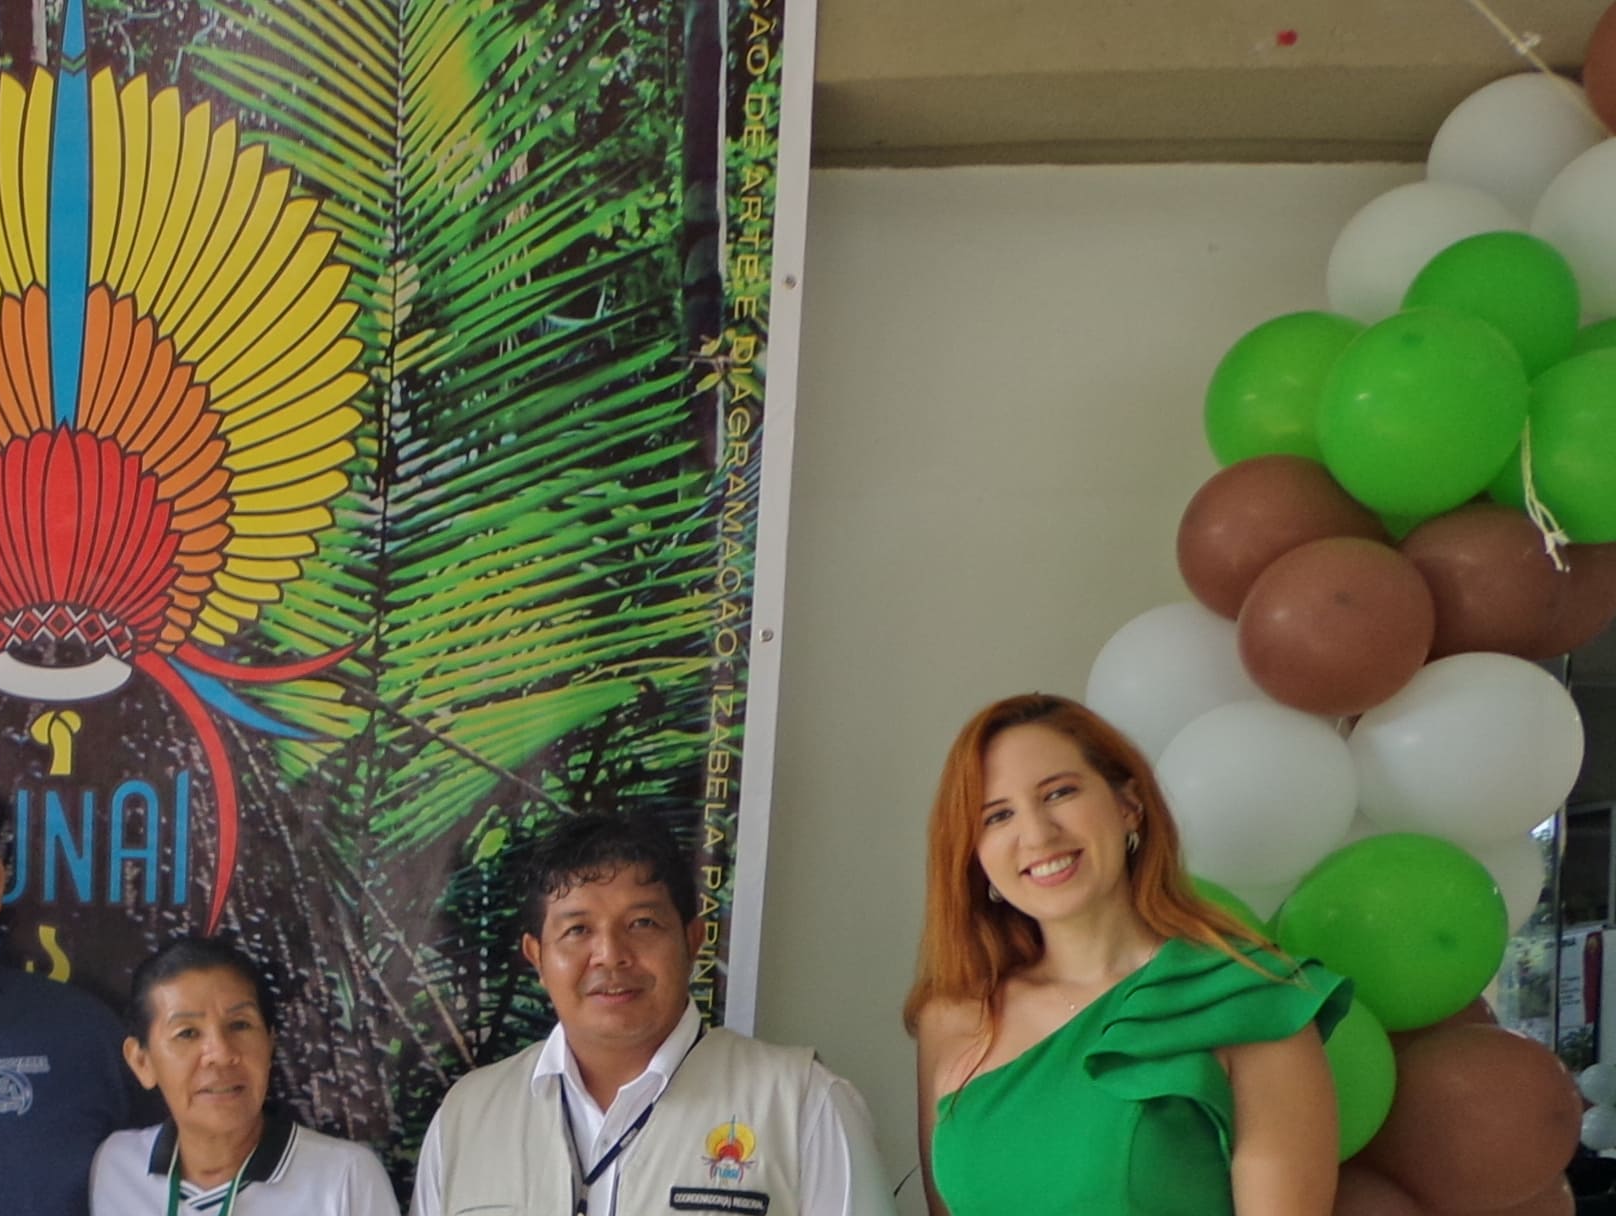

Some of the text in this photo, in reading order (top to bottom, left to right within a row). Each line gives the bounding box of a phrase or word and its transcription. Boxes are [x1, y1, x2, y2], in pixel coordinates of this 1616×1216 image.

[743, 93, 769, 148] DE
[737, 166, 763, 278] ARTE
[734, 296, 757, 319] E
[703, 684, 735, 849] IZABELA
